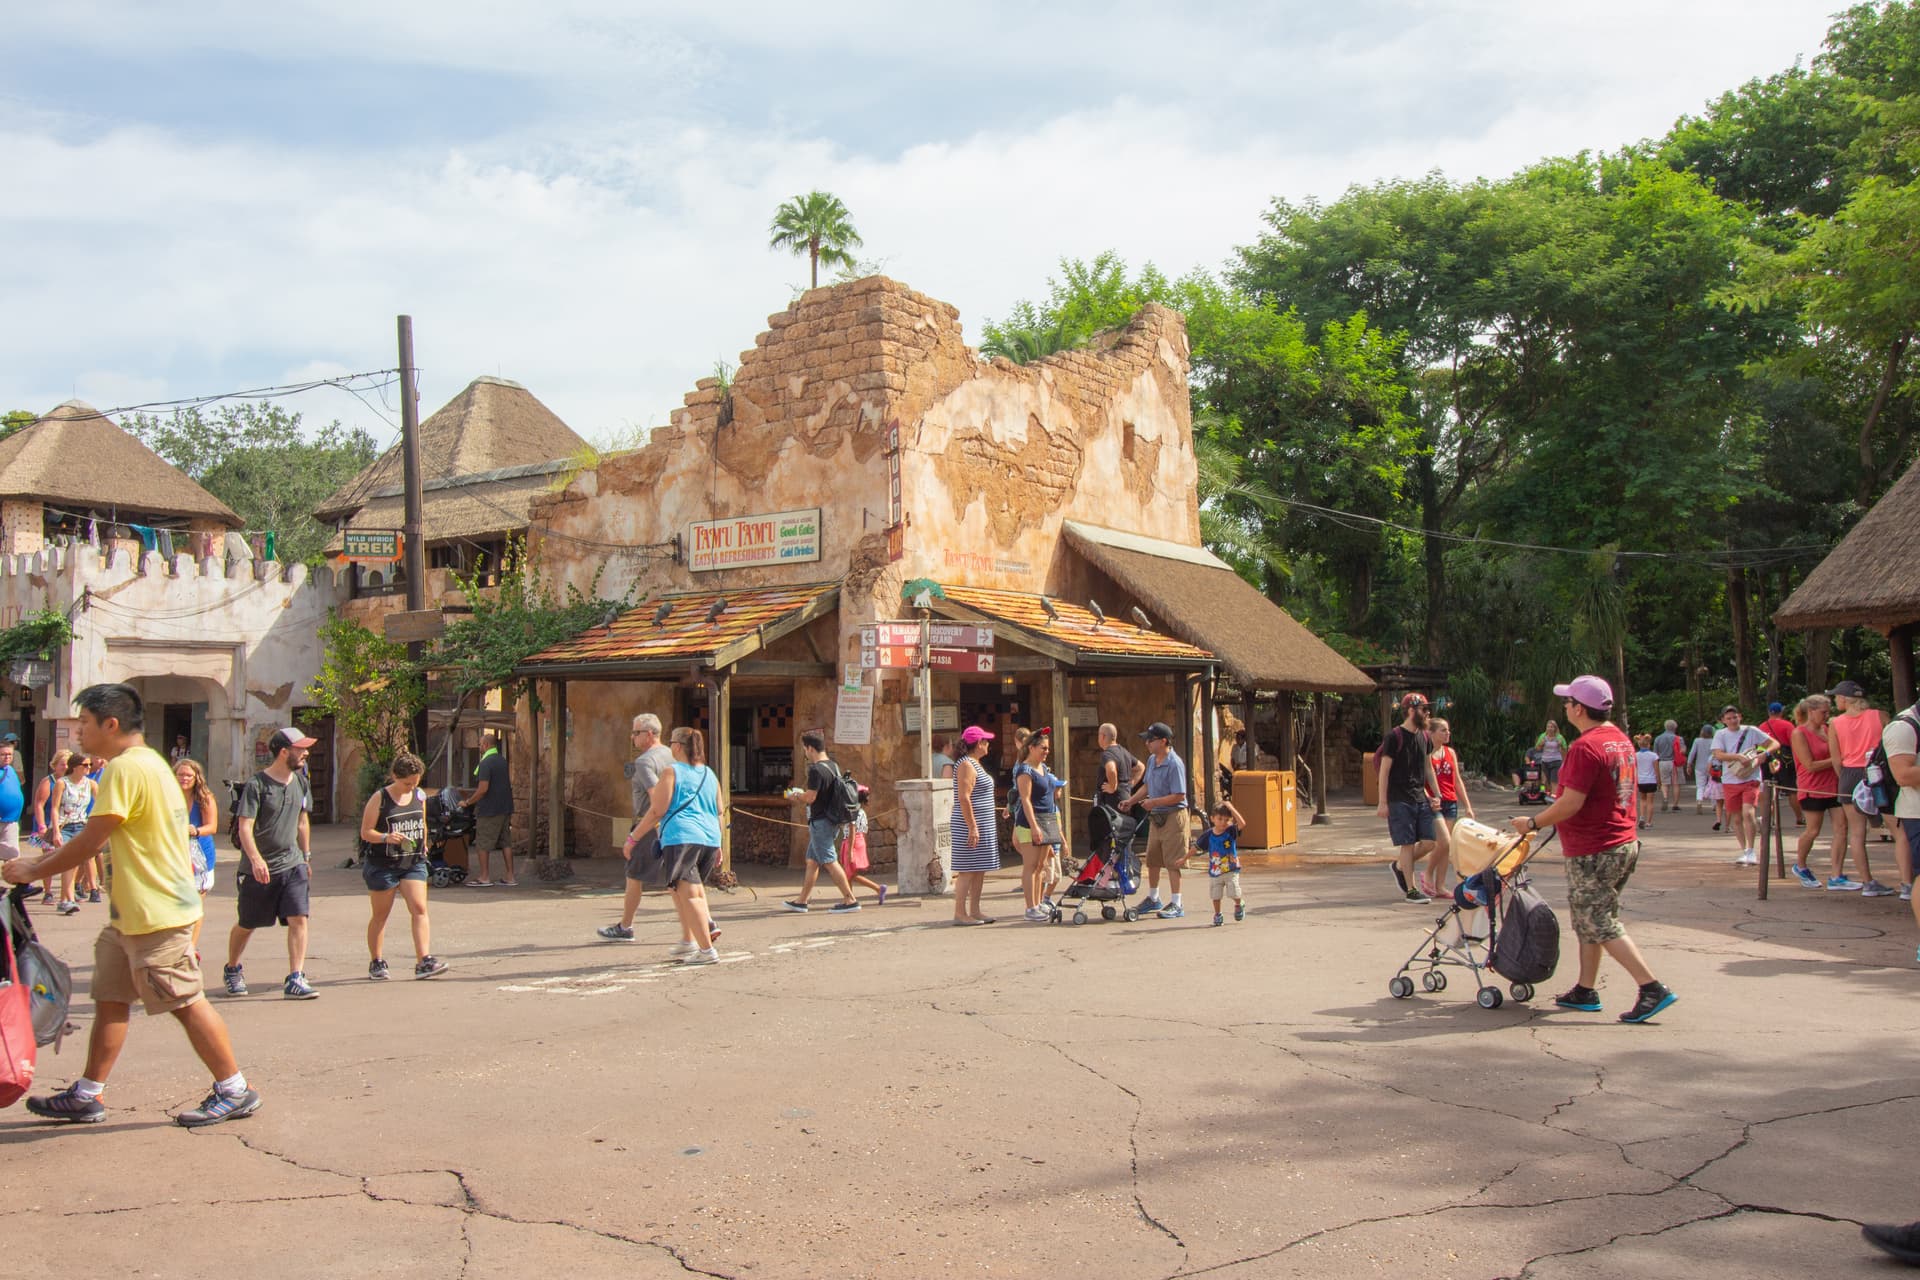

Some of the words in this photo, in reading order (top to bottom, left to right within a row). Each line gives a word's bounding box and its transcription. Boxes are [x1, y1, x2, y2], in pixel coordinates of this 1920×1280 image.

[347, 535, 366, 543] WILD
[694, 525, 733, 551] TAMU
[736, 521, 776, 547] TAMU
[347, 542, 395, 554] TREK
[720, 546, 777, 564] REFRESHMENTS
[936, 656, 952, 665] ASIA
